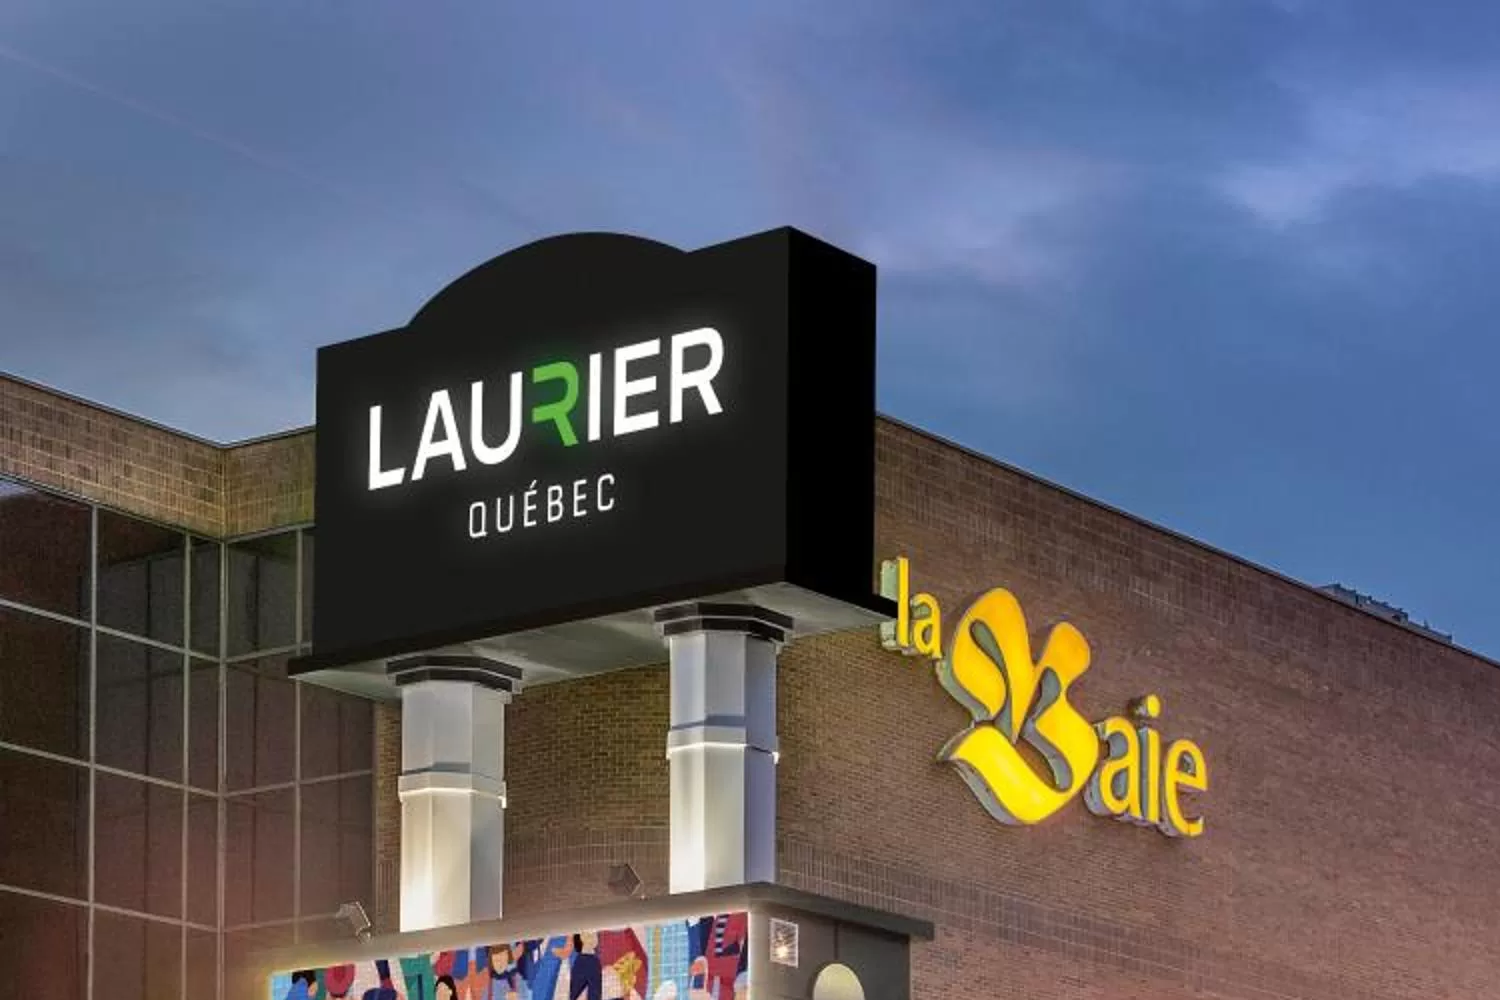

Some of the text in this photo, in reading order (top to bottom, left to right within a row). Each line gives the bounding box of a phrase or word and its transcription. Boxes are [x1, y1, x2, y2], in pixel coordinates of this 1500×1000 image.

[368, 326, 725, 491] LAURIER
[468, 473, 615, 538] QUÉBEC
[894, 556, 942, 659] la
[946, 587, 1208, 837] Baie
